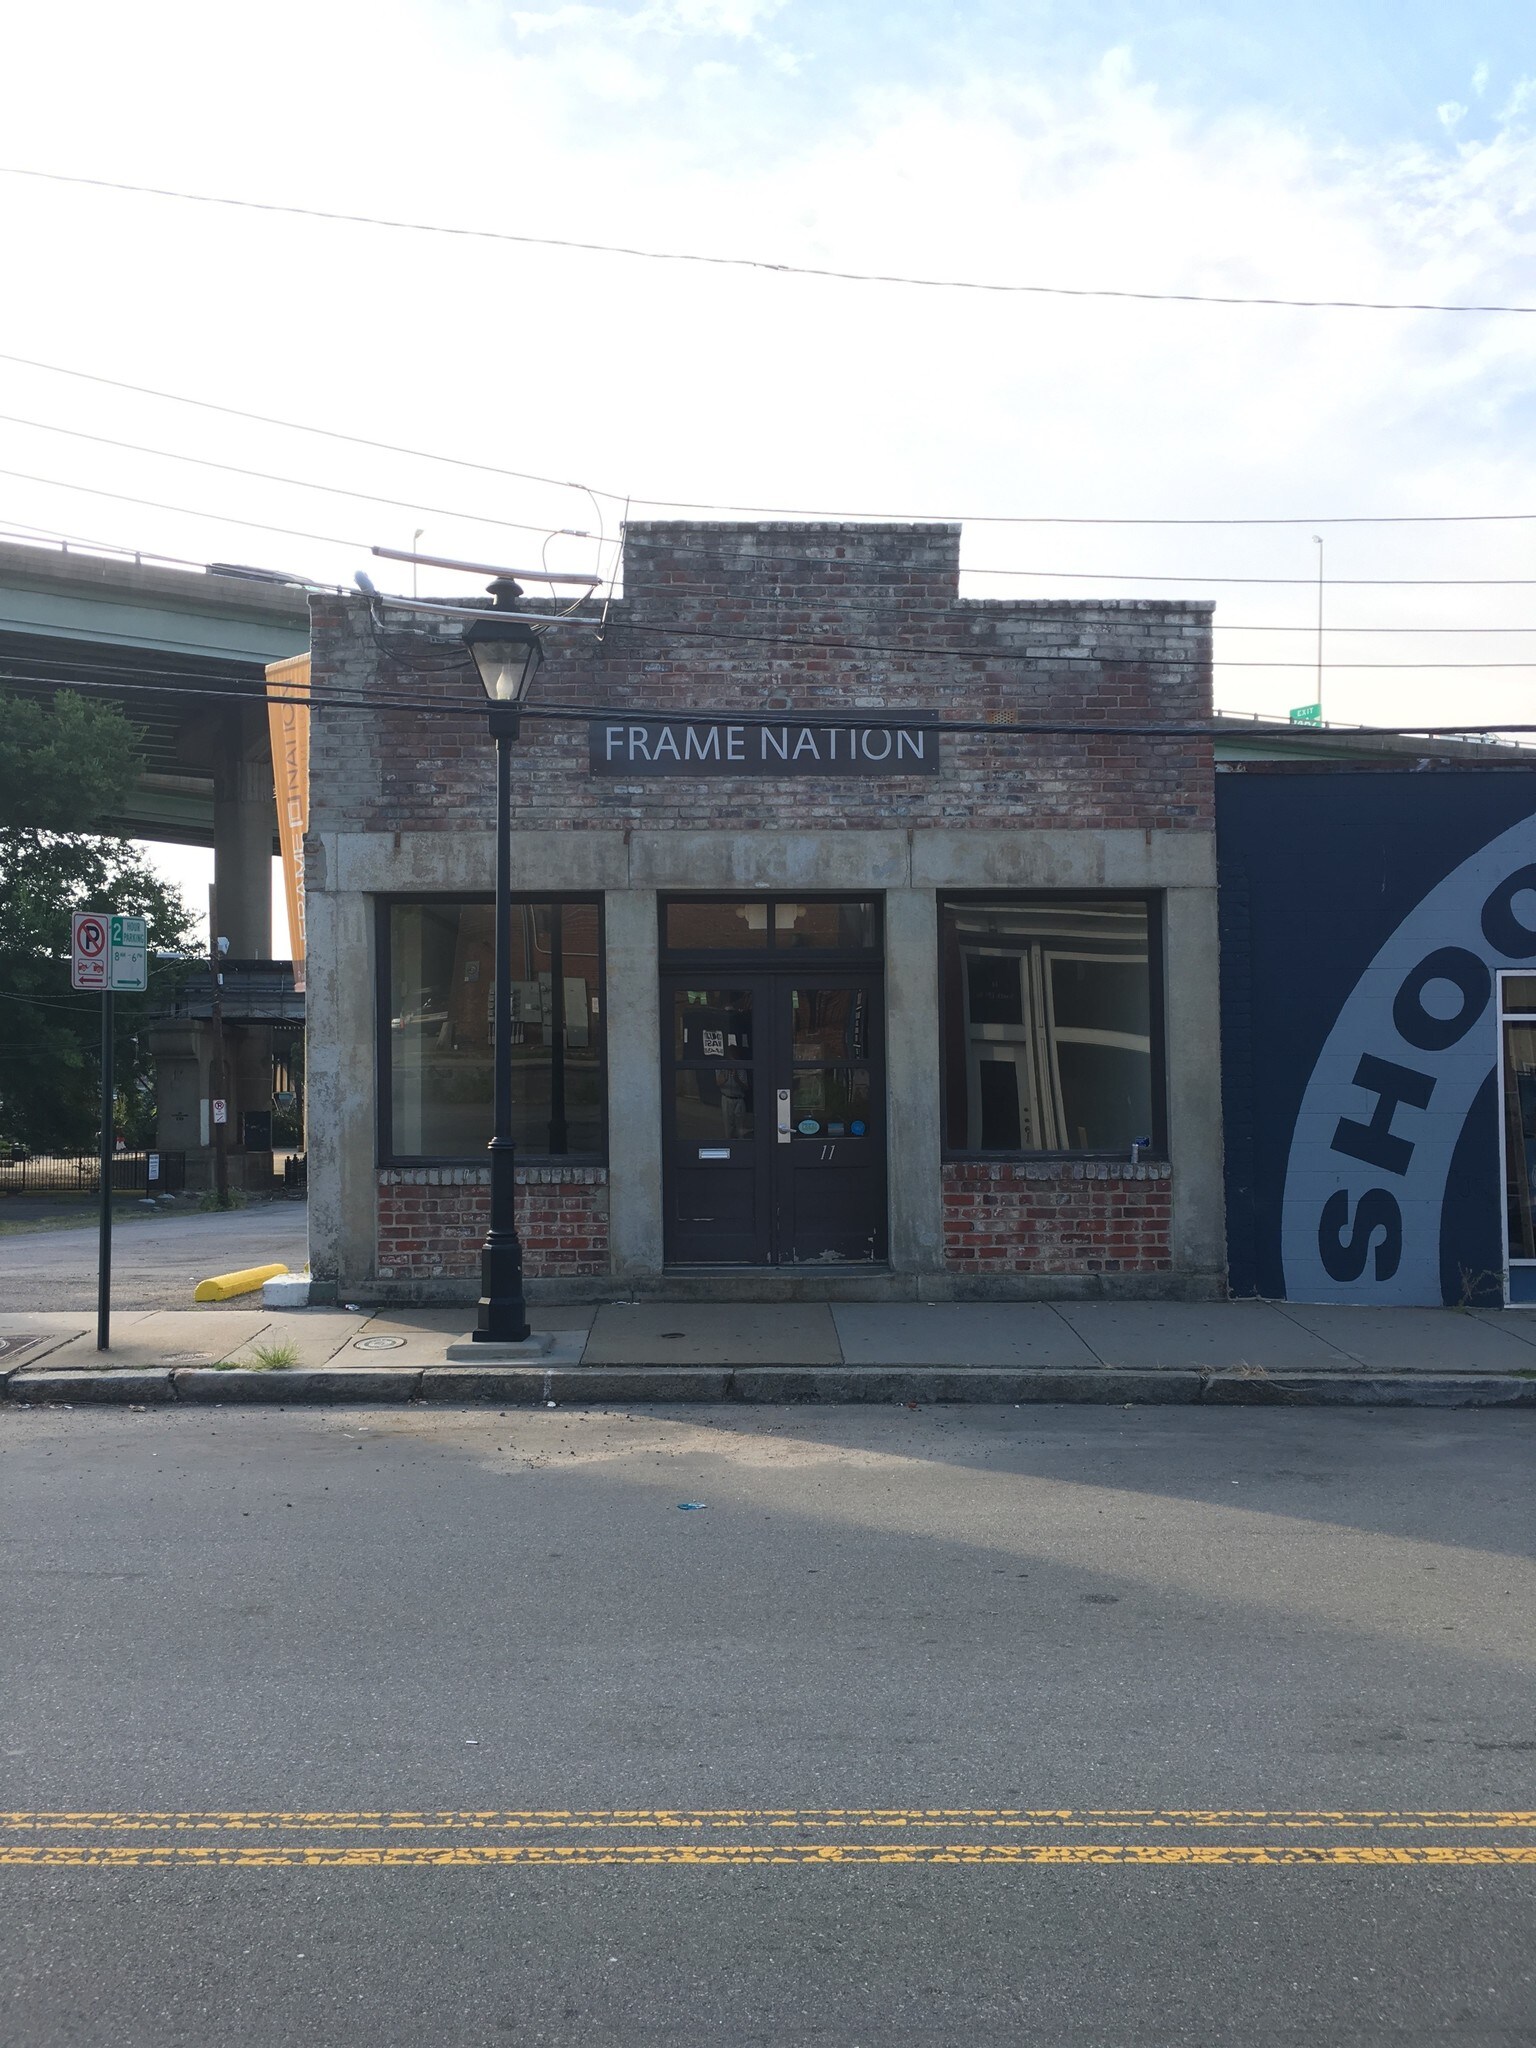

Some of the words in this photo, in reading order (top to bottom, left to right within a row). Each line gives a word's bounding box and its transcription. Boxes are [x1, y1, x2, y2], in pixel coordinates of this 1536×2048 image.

[1297, 706, 1314, 717] EXIT
[605, 725, 747, 762] FRAME
[760, 726, 926, 761] NATION
[113, 923, 122, 942] 2
[126, 921, 141, 932] HOUR
[124, 933, 144, 944] PARKING
[820, 1144, 836, 1160] 11
